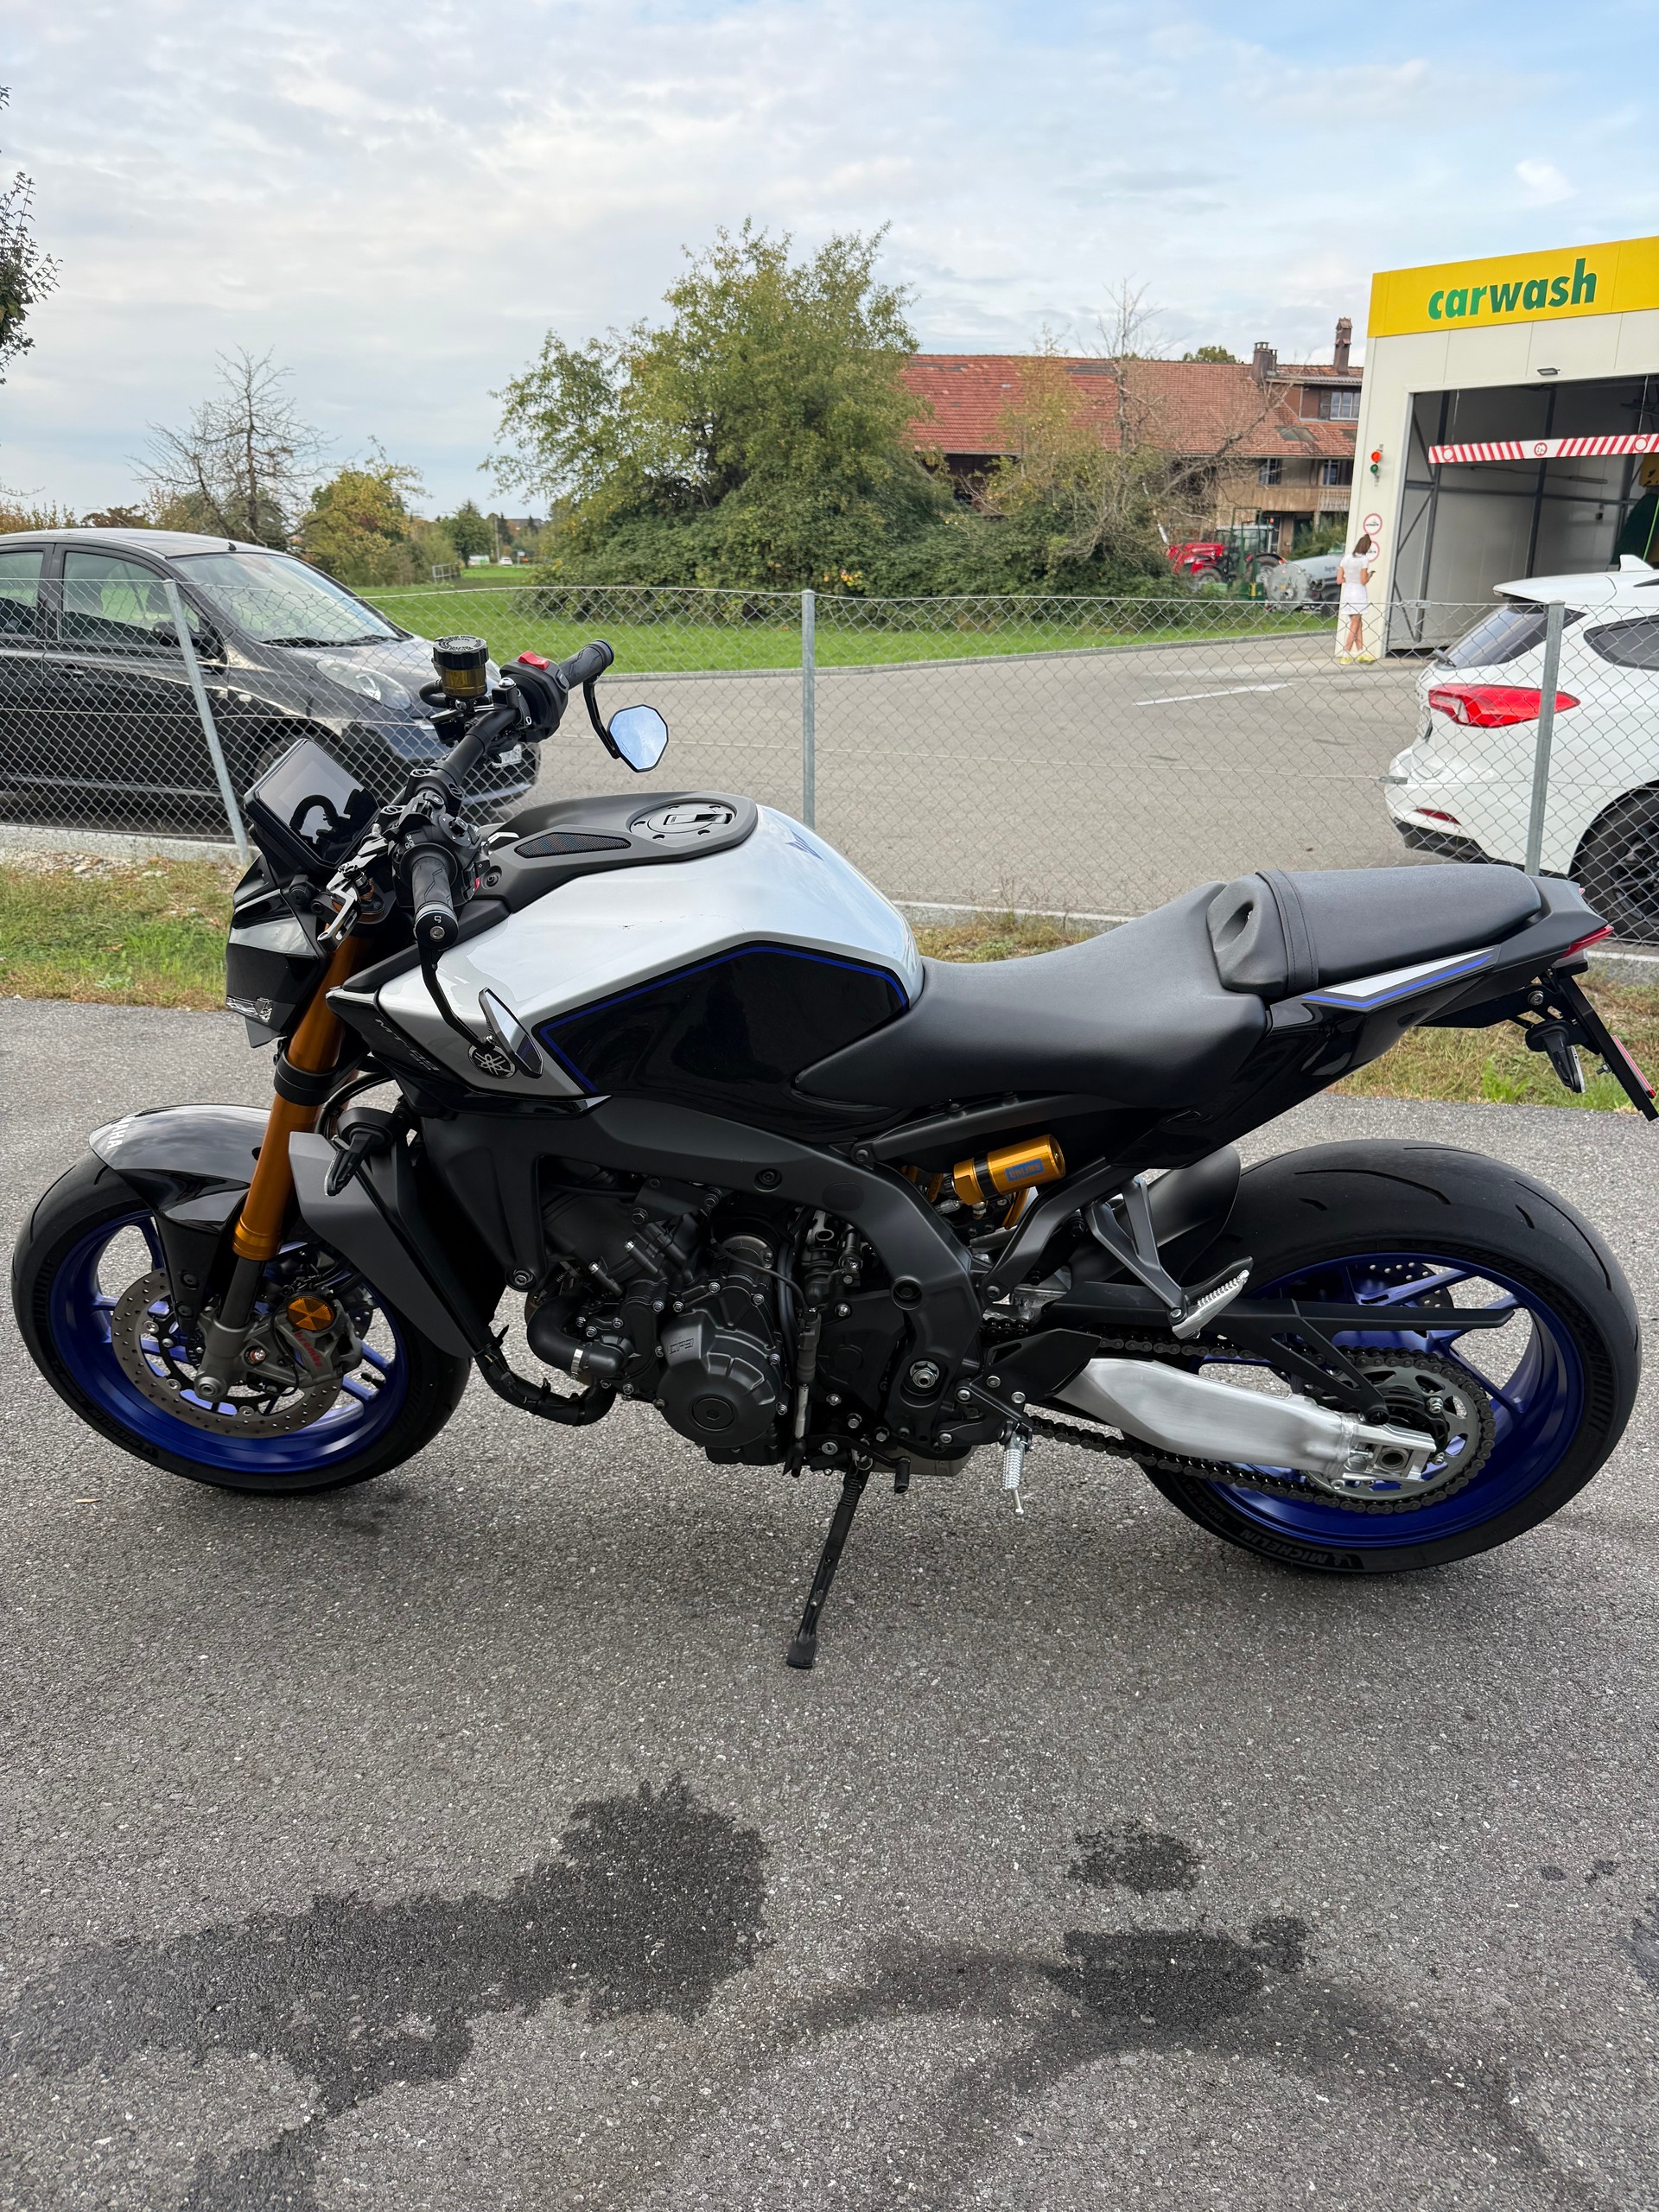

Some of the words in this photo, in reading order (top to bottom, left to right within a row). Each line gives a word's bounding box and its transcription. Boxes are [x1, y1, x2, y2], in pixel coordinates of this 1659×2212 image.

[1428, 257, 1598, 320] carwash
[294, 1332, 323, 1368] brembo
[1239, 1528, 1331, 1566] MICHELIN
